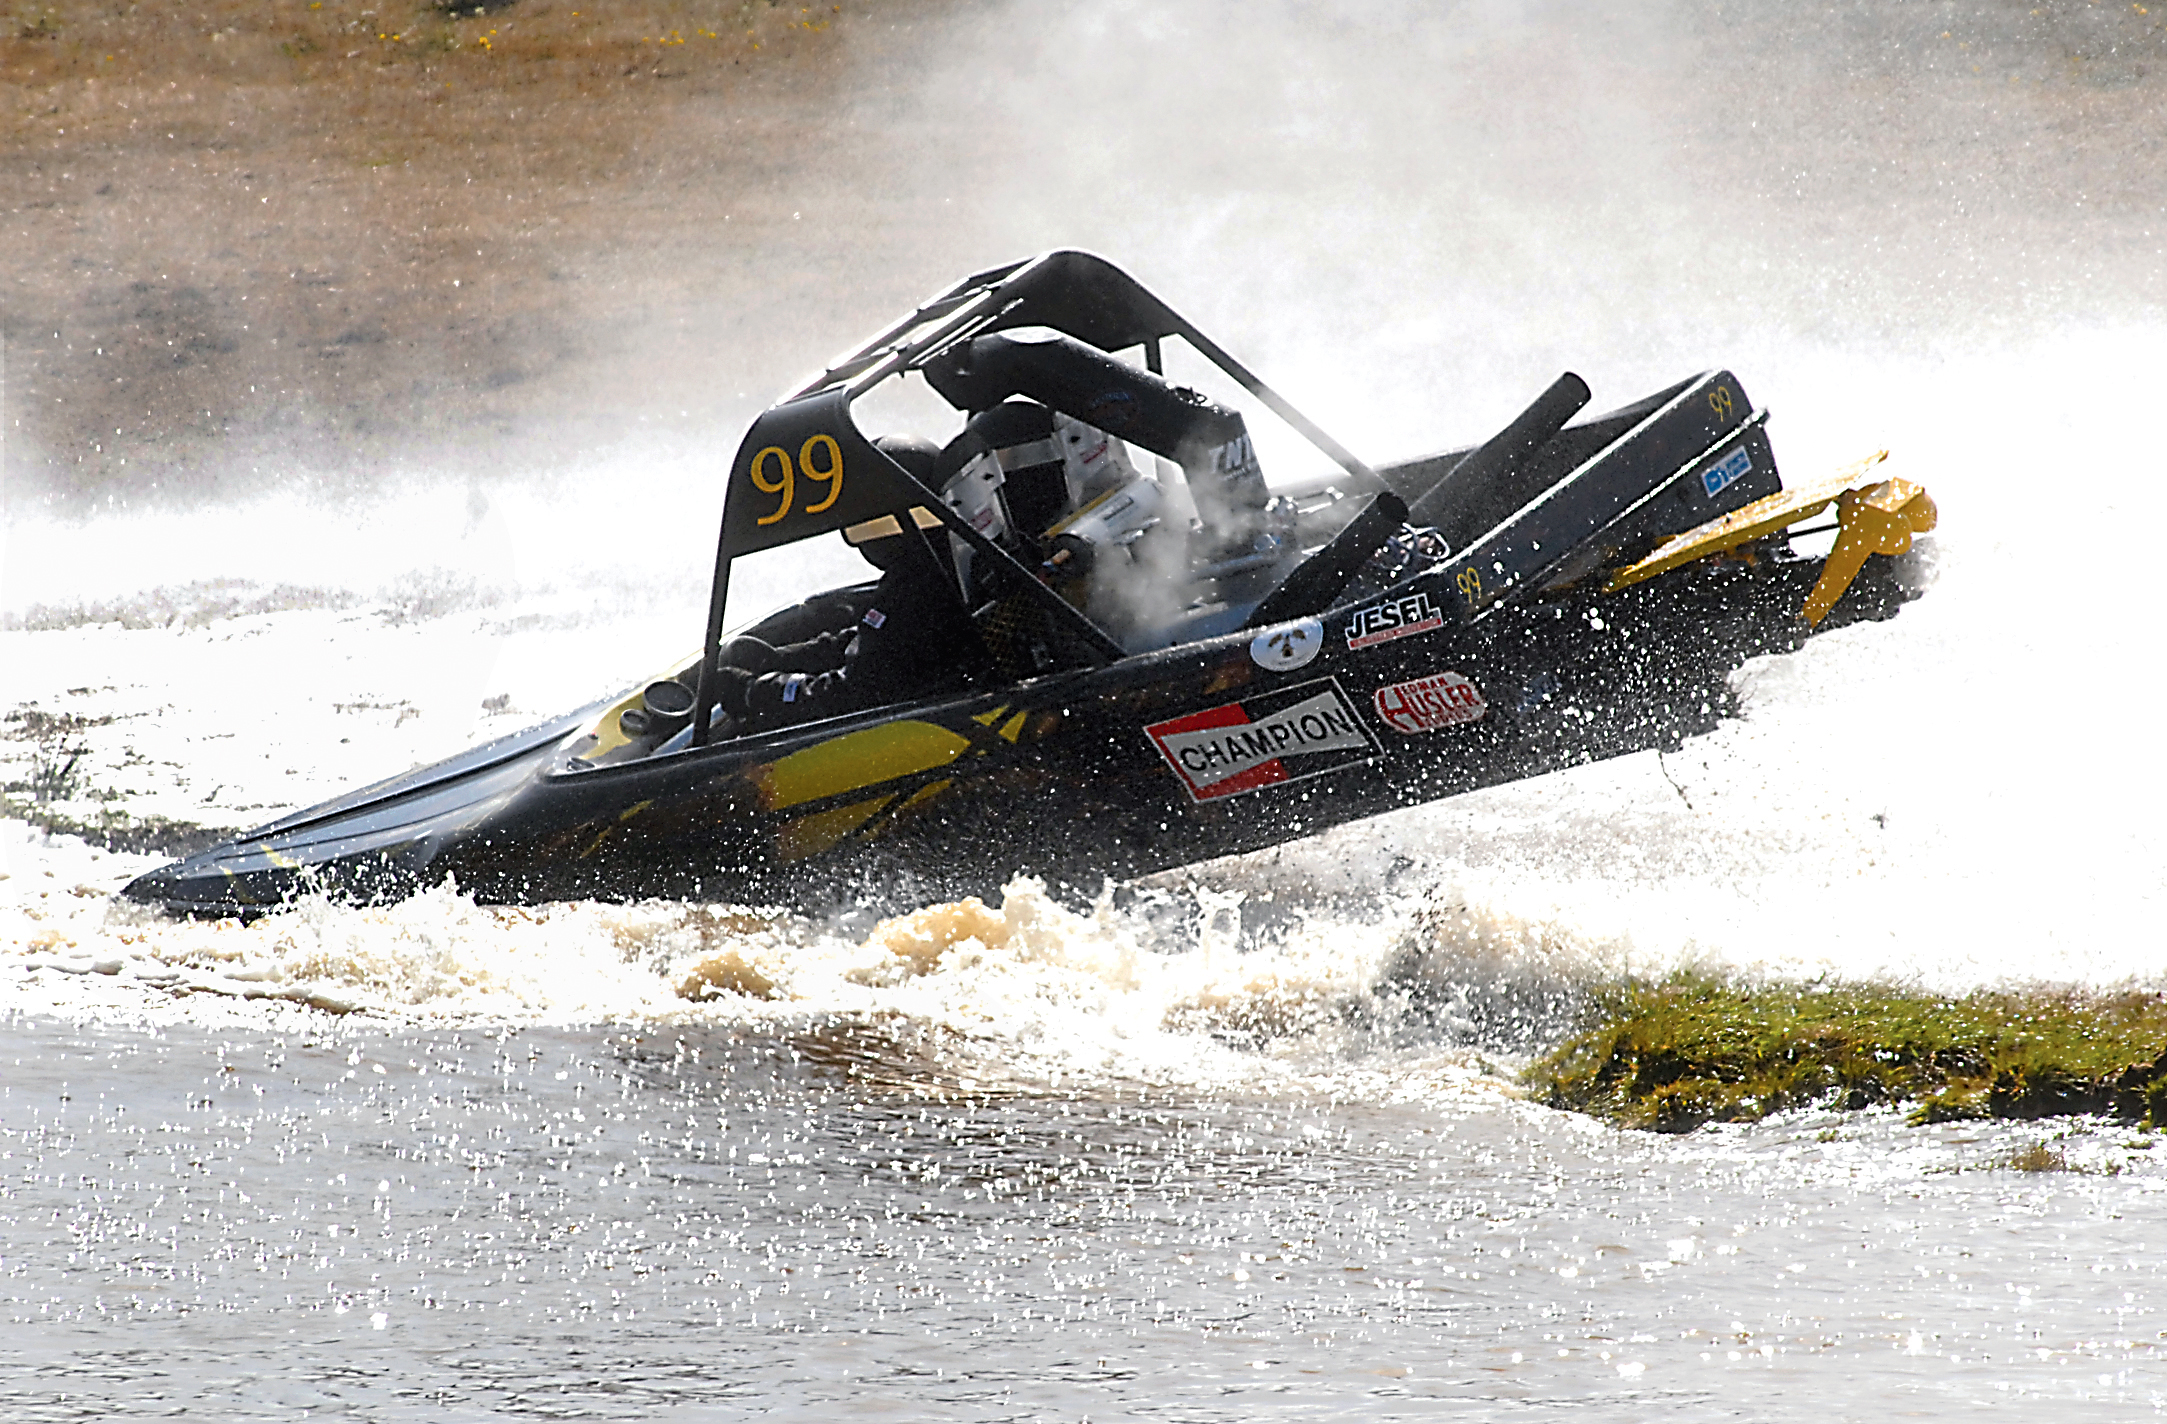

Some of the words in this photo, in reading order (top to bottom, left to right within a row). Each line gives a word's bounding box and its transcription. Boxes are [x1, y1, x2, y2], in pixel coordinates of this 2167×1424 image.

[1708, 386, 1732, 422] 99
[751, 434, 843, 525] 99
[1457, 567, 1481, 603] 99
[1345, 594, 1441, 640] JESEL
[1179, 707, 1355, 772] CHAMPION
